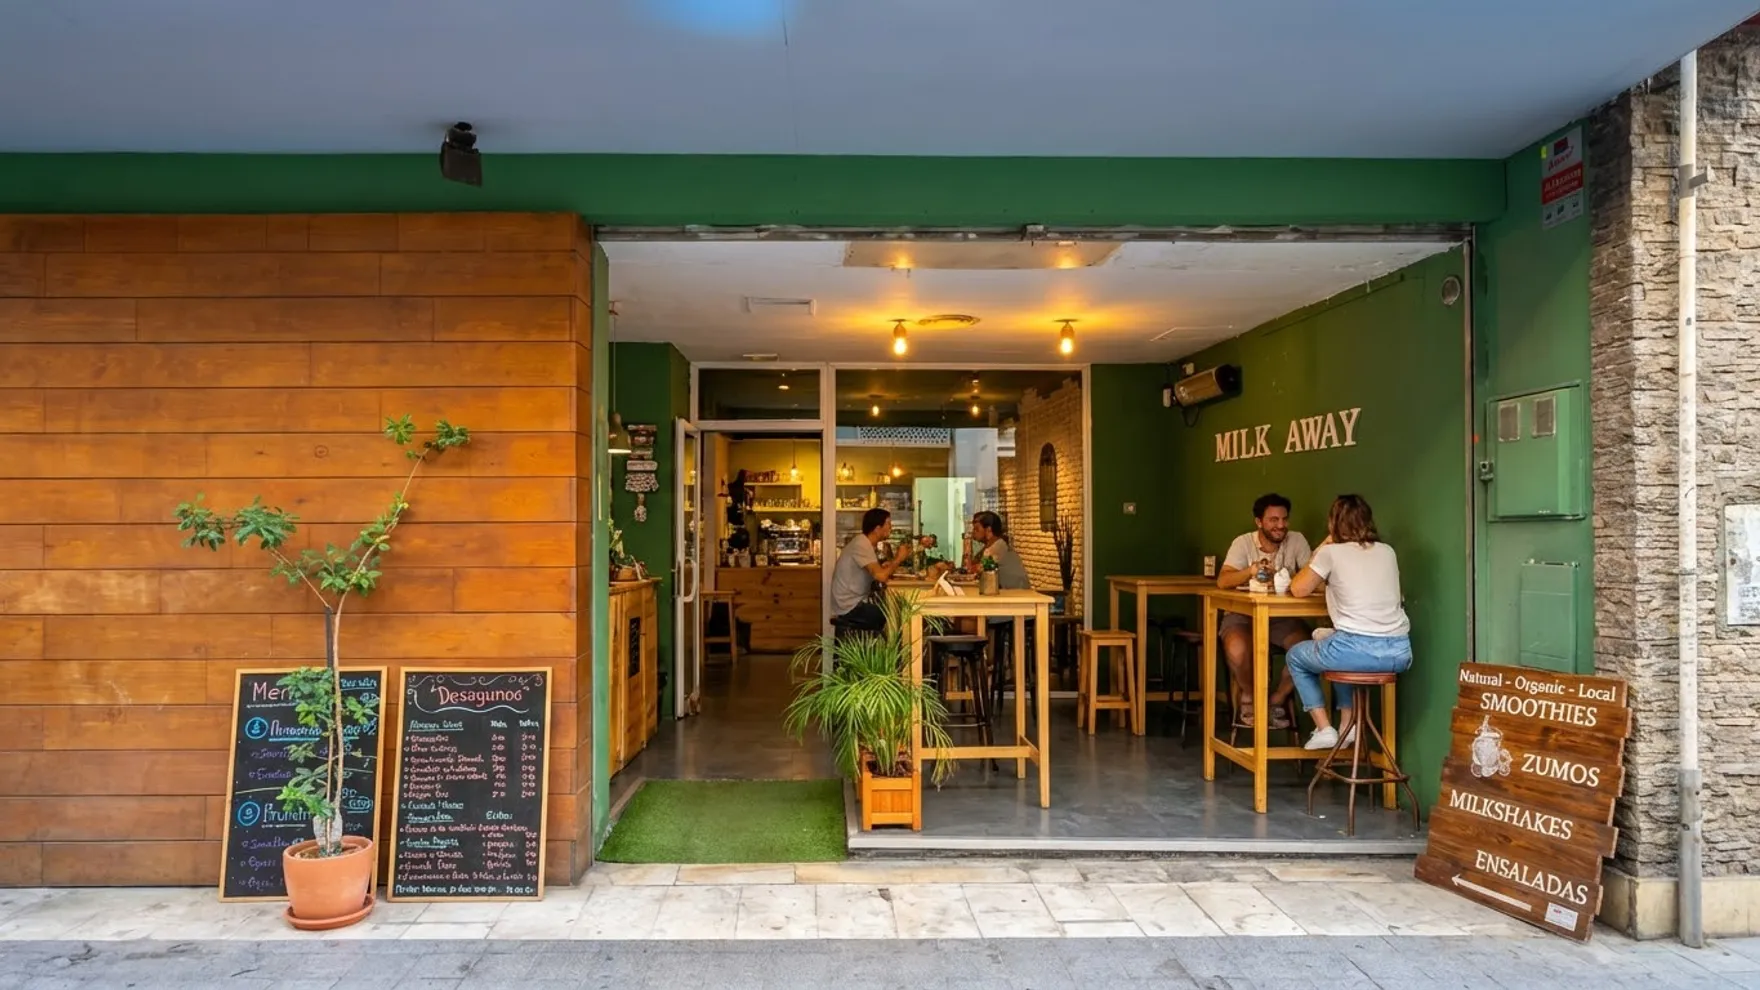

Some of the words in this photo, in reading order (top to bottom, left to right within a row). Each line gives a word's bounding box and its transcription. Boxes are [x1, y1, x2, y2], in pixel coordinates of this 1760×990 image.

[1215, 424, 1272, 462] MILK
[1283, 407, 1362, 453] AWAY
[1459, 668, 1502, 687] Natural
[1578, 683, 1617, 702] Local
[1480, 692, 1598, 727] SMOOTHIES
[1521, 753, 1600, 787] ZUMOS
[1449, 788, 1574, 840] MILKSHAKES
[1475, 849, 1589, 905] ENSALADAS
